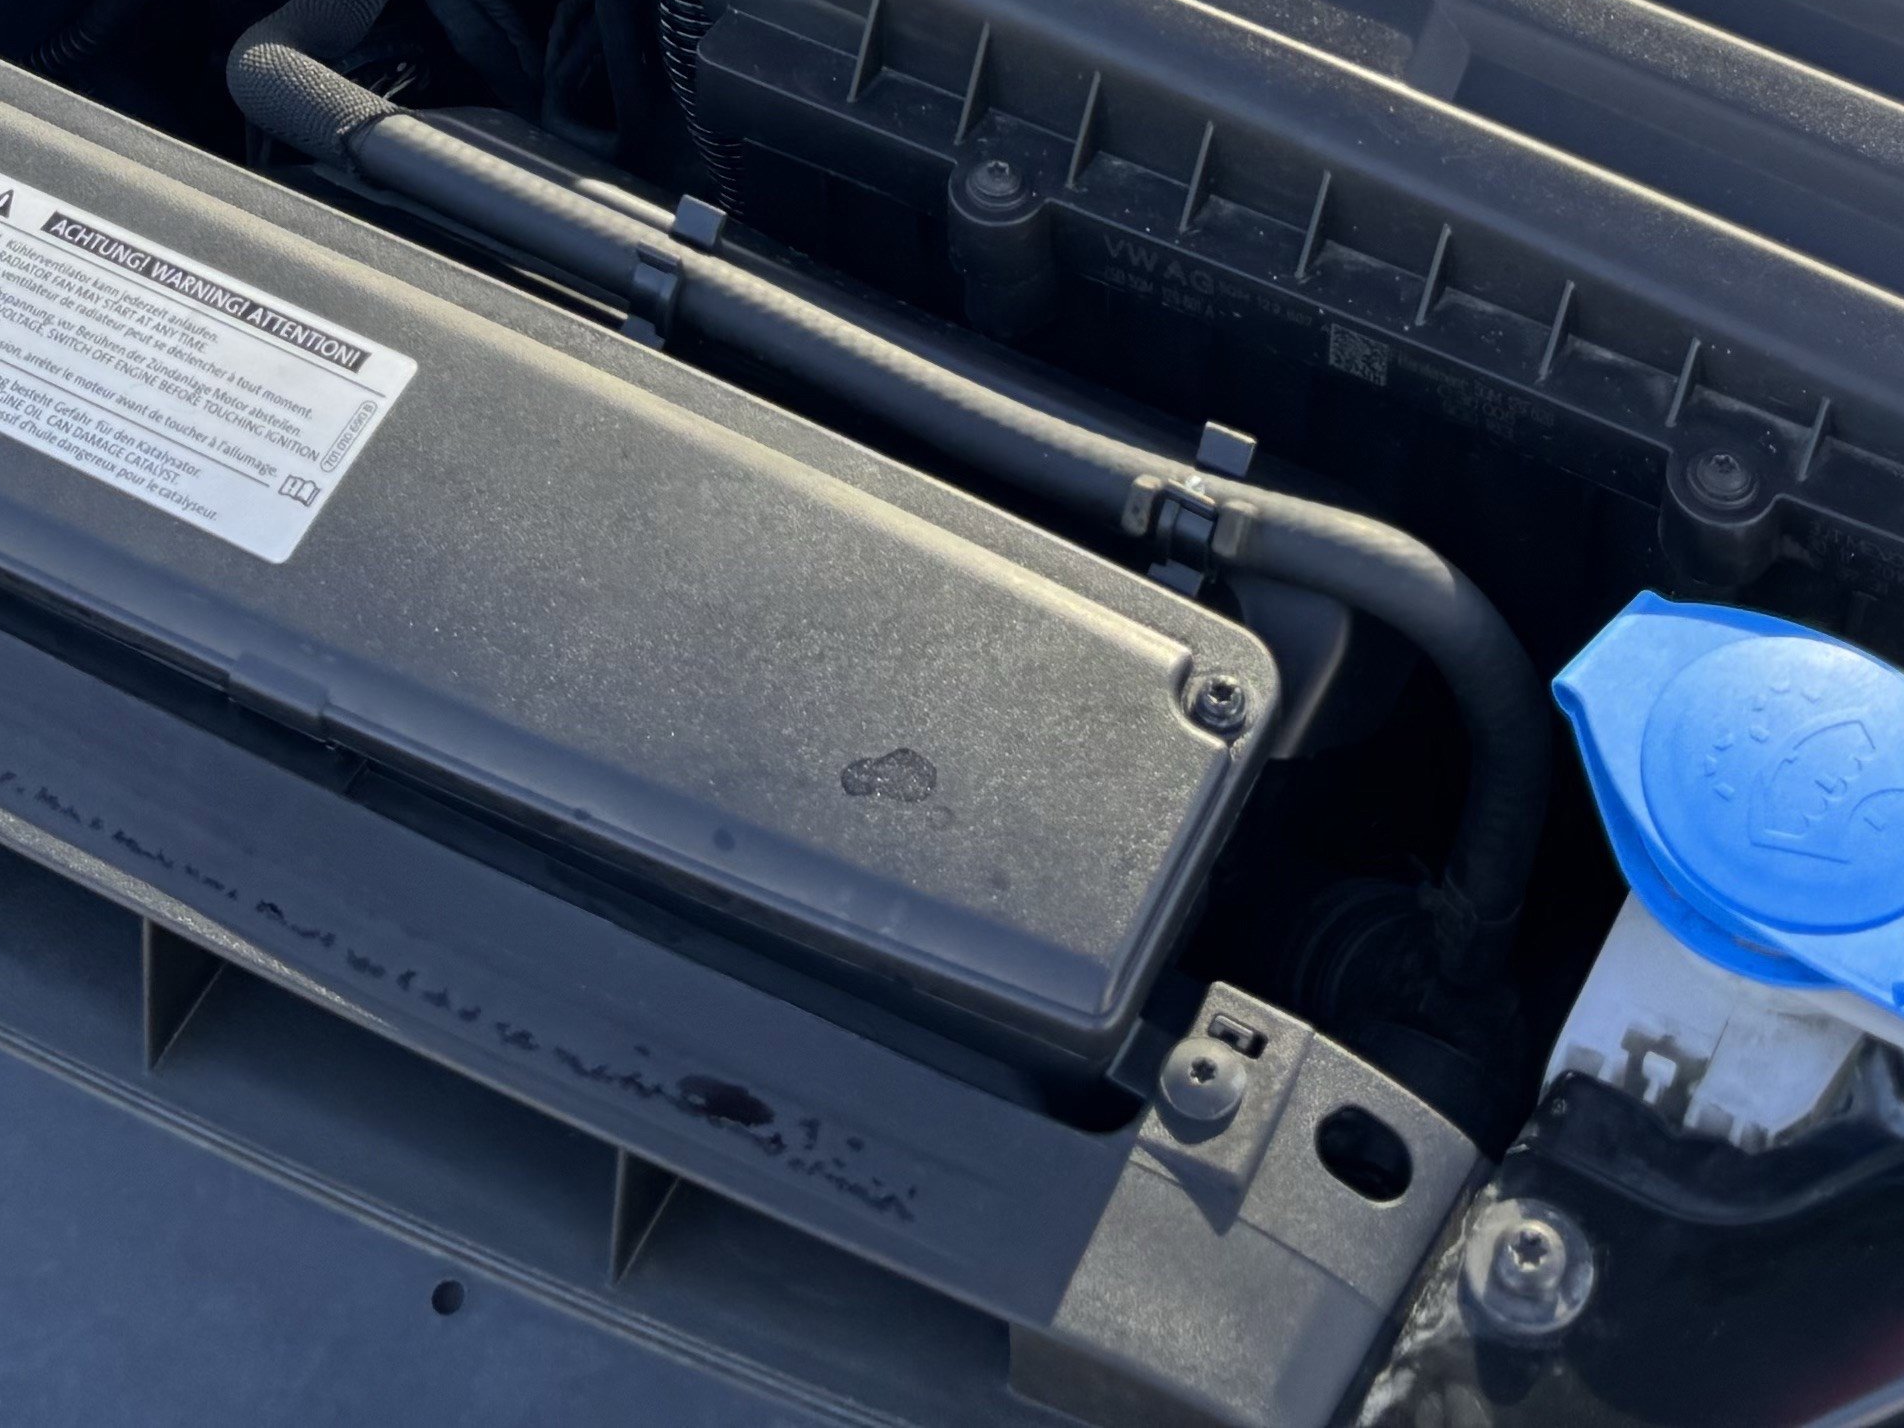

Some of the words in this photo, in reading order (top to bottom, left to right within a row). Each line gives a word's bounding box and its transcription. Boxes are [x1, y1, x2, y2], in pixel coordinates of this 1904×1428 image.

[49, 274, 76, 293] FAN
[73, 284, 103, 305] MAY
[100, 297, 138, 320] START
[135, 313, 154, 327] AT
[150, 320, 179, 338] ANY
[50, 218, 151, 271] ACHTUNG!
[150, 260, 250, 316] WARNING!
[246, 306, 360, 367] ATTENTION!
[90, 277, 120, 298] kann
[0, 269, 60, 302] ventilateur
[58, 294, 75, 310] de
[73, 302, 126, 331] radiateur
[122, 326, 154, 346] peut
[235, 375, 263, 396] tout
[8, 379, 54, 408] besteht
[52, 400, 93, 426] Gefahr
[112, 429, 136, 447] den
[45, 327, 93, 355] SWITCH
[90, 348, 116, 365] OFF
[112, 358, 159, 387] ENGINE
[156, 378, 202, 407] BEFORE
[202, 398, 266, 437] TOUCHING
[263, 428, 320, 462] IGNITION
[72, 374, 116, 400] moteur
[114, 393, 149, 416] avant
[146, 409, 164, 423] de
[163, 415, 209, 443] toucher
[124, 349, 146, 364] der
[210, 386, 249, 412] Motor
[22, 402, 43, 421] OIL
[45, 413, 74, 434] CAN
[70, 425, 126, 459] DAMAGE
[55, 437, 117, 473] dangereux
[114, 466, 146, 486] pour
[144, 477, 159, 493] le
